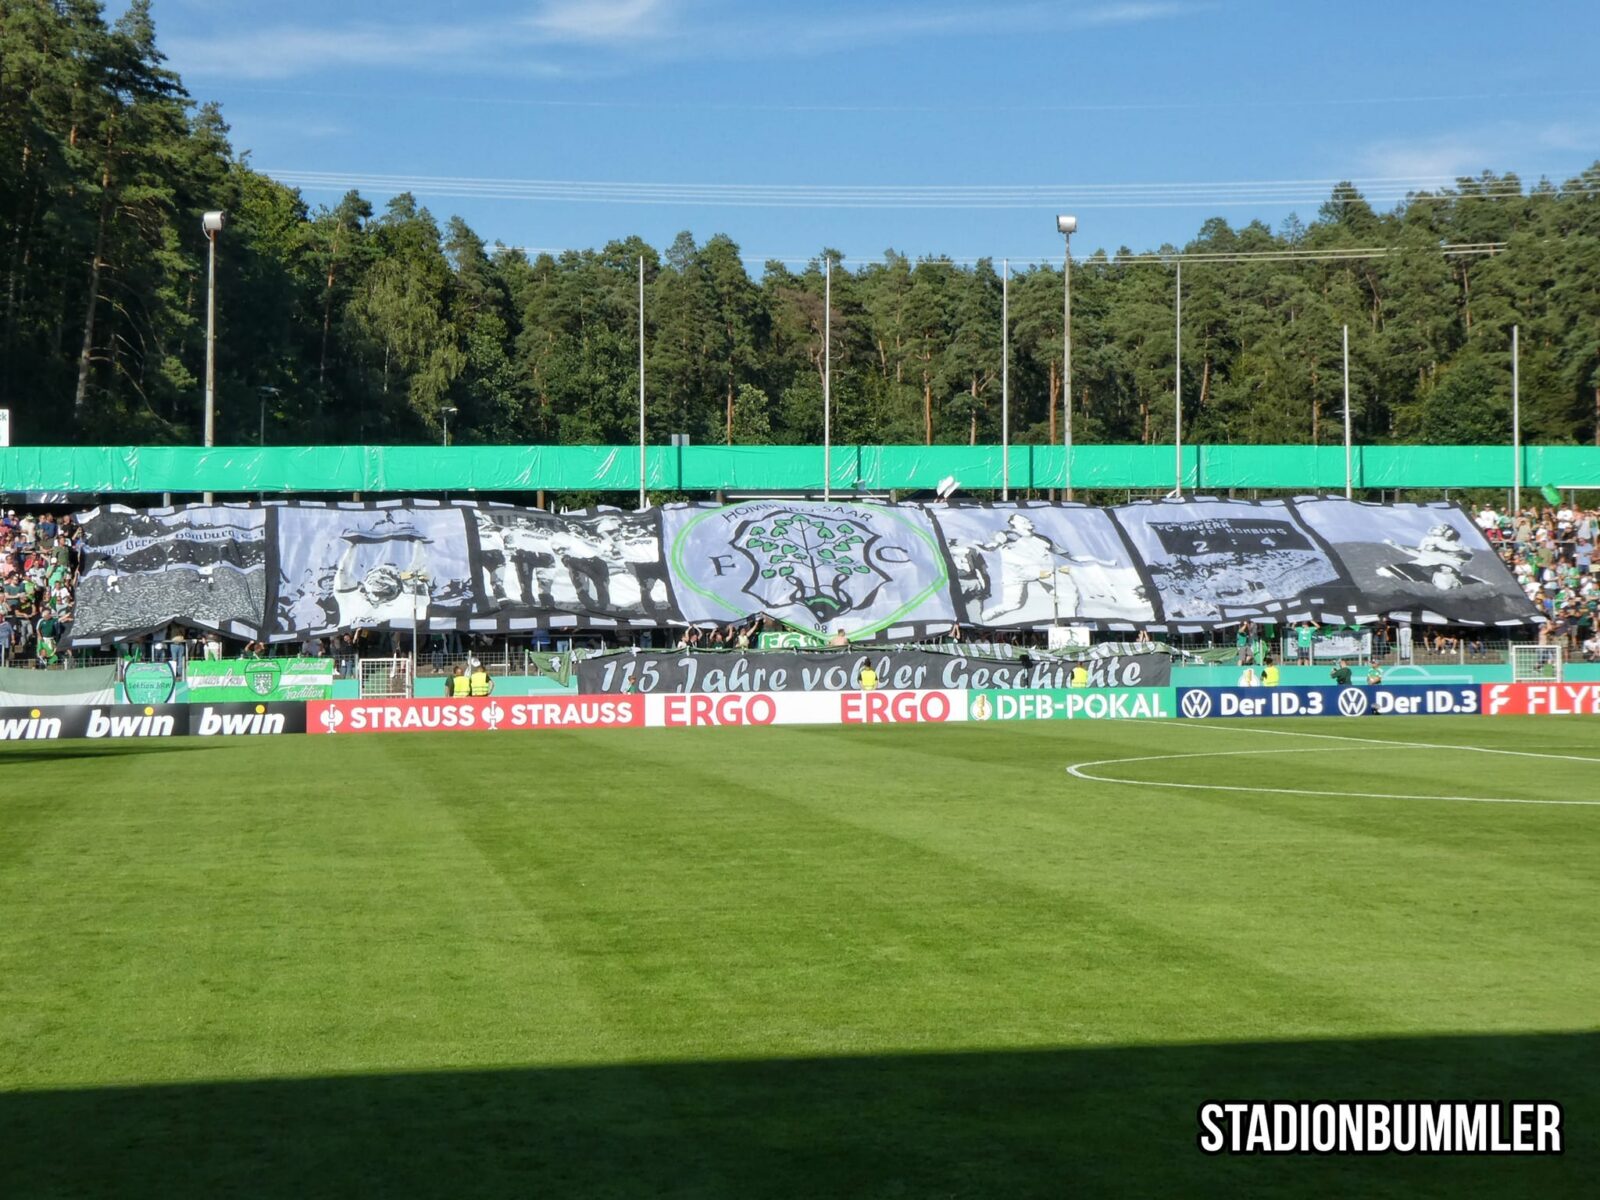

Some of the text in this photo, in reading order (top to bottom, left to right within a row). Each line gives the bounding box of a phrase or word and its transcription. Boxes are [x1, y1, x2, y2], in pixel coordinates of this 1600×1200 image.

[1192, 541, 1209, 553] 2
[1260, 537, 1276, 547] 4
[708, 546, 911, 577] F C
[814, 622, 828, 634] 08
[602, 661, 659, 692] 115
[677, 656, 787, 693] Jahre
[801, 656, 927, 691] voller
[511, 702, 633, 725] STRAUSS
[664, 694, 777, 727] ERGO
[840, 691, 951, 723] ERGO
[996, 692, 1168, 719] DFB-POKAL
[1220, 692, 1323, 716] Der ID.3
[1375, 690, 1477, 714] Der ID.3
[86, 706, 174, 738] bwin
[198, 704, 285, 736] bwin
[351, 704, 475, 729] STRAUSS
